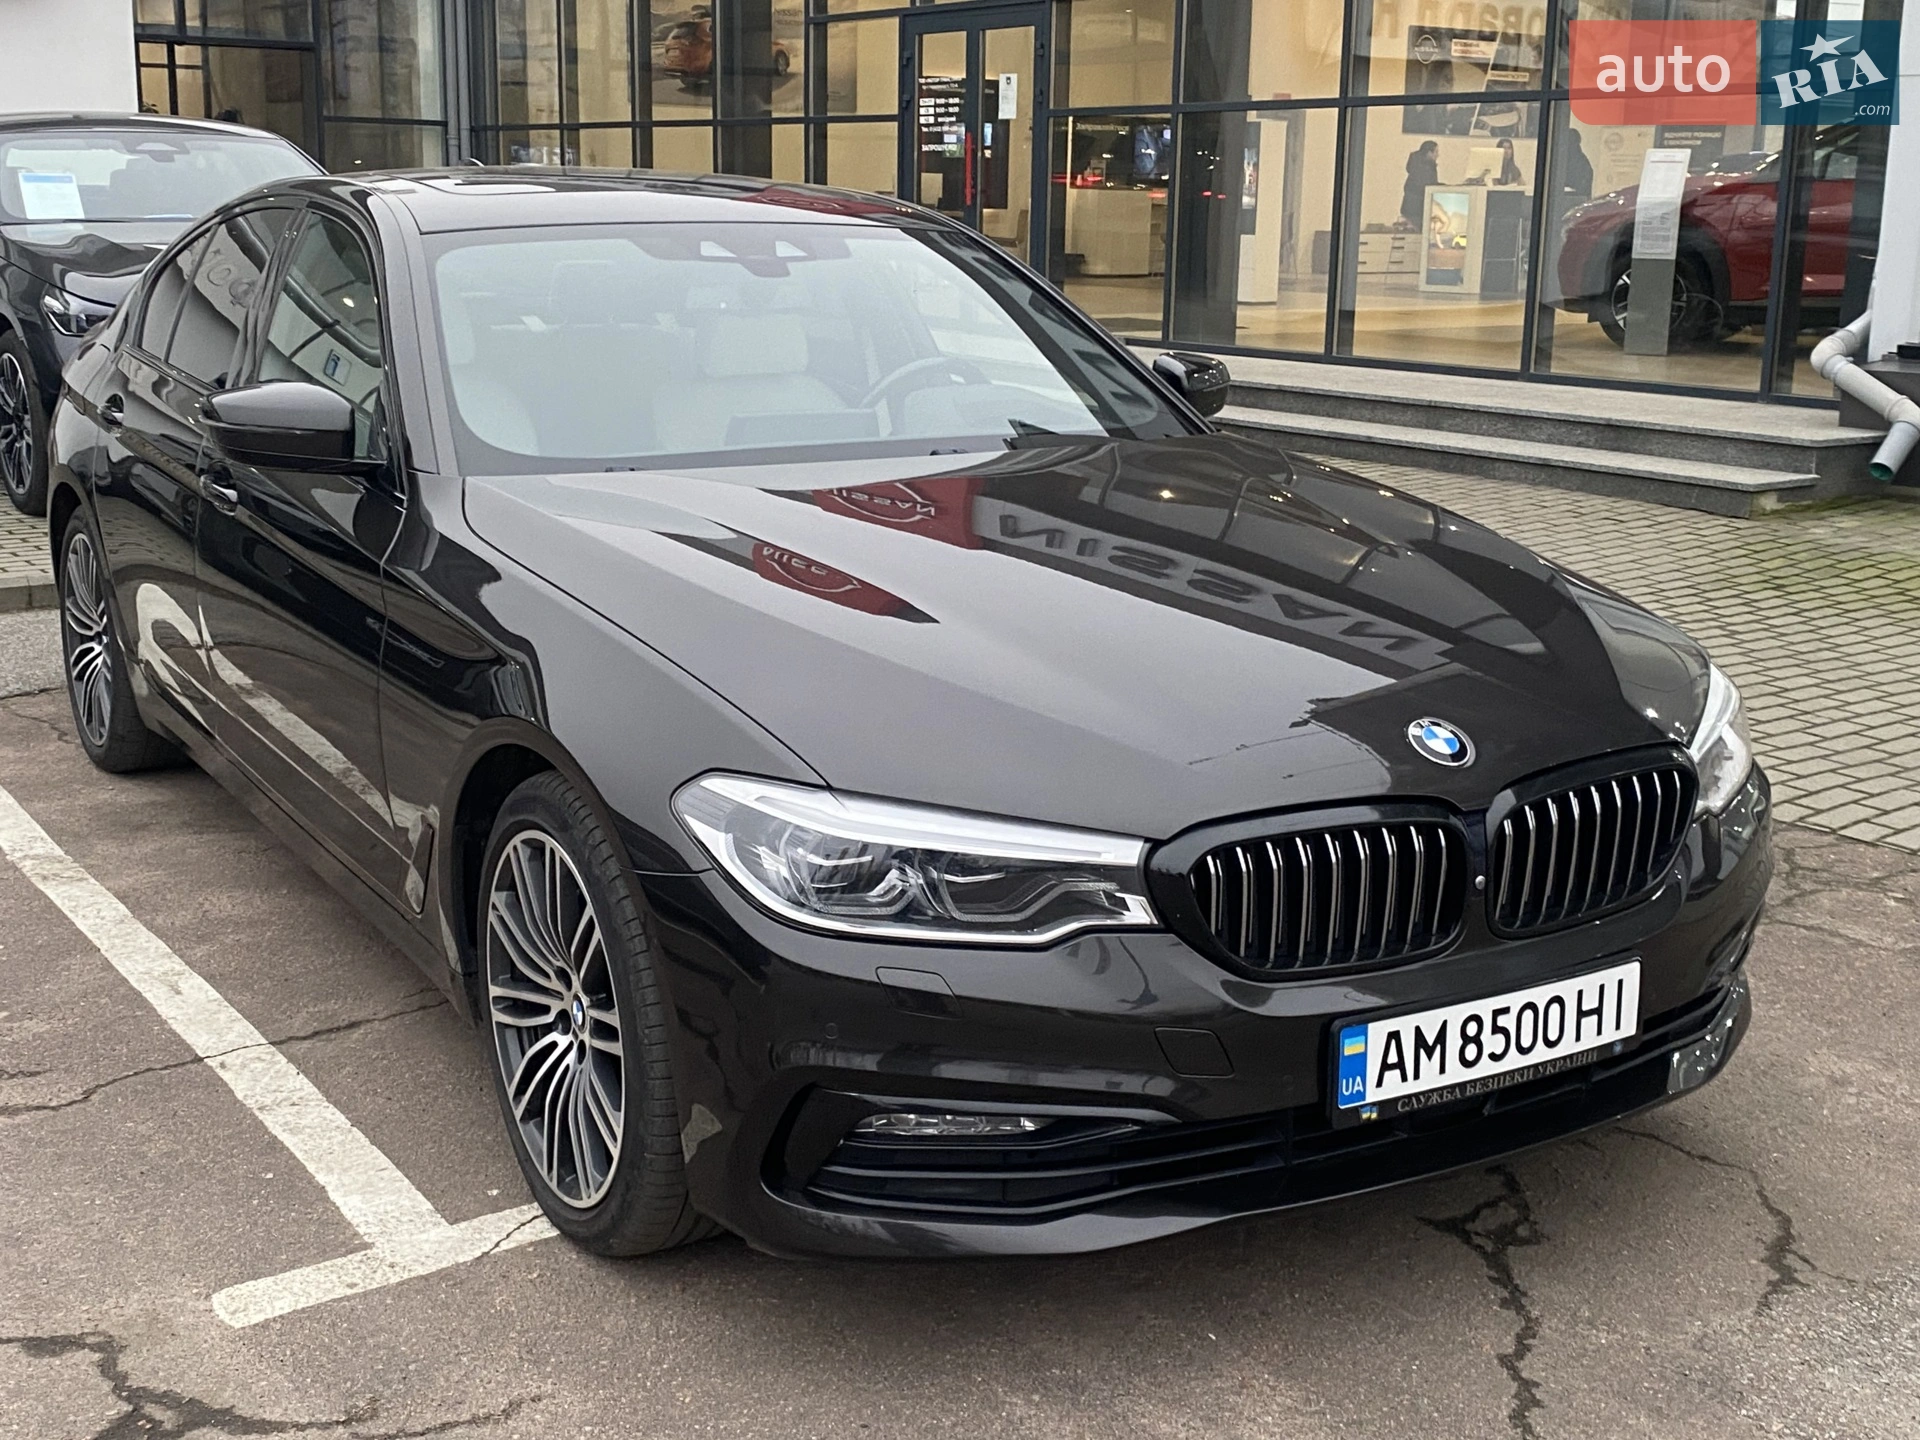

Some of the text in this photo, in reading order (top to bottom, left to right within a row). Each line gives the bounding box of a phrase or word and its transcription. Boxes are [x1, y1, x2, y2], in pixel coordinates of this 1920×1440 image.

[1342, 1076, 1364, 1096] UA
[1397, 1085, 1462, 1112] СЛУЖБА
[1465, 1066, 1535, 1097] БЕЗПЕКИ
